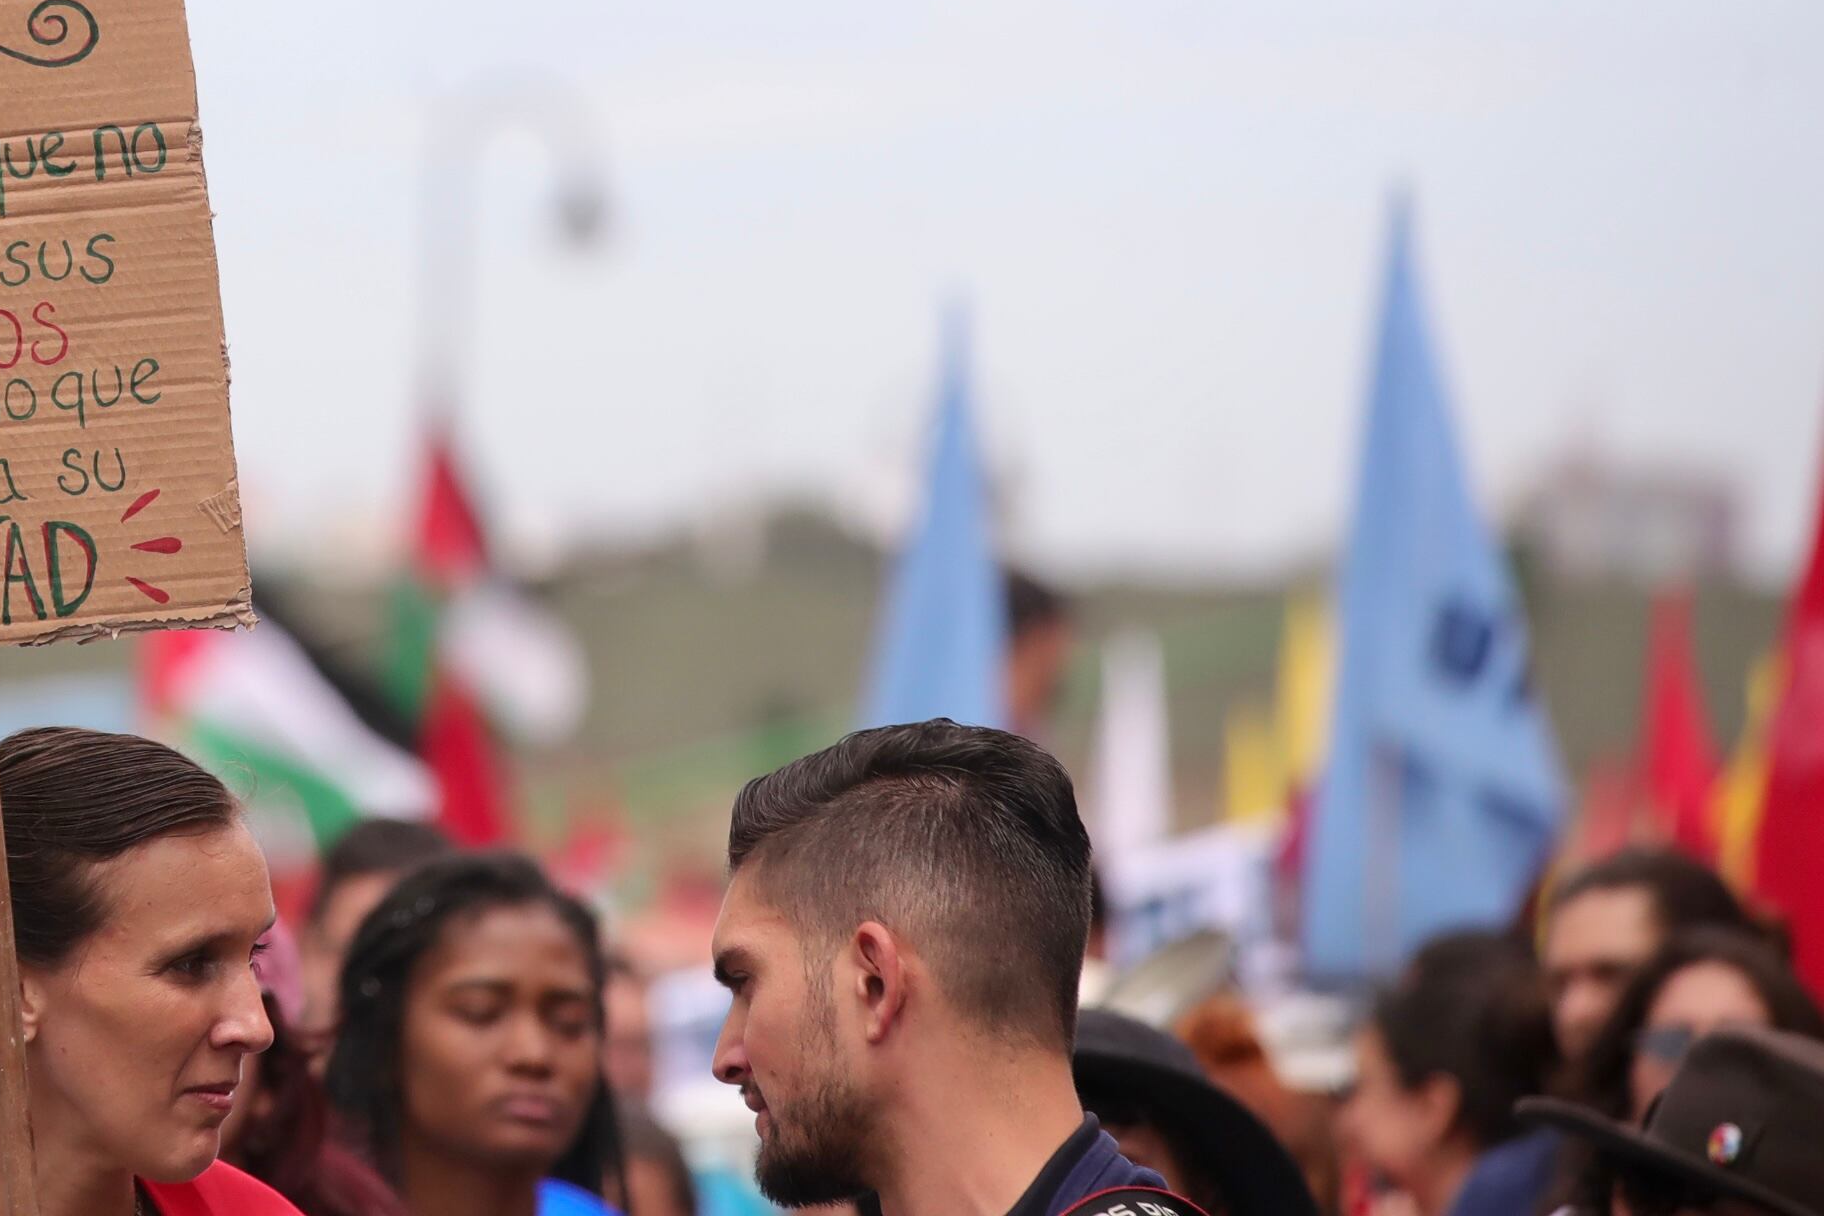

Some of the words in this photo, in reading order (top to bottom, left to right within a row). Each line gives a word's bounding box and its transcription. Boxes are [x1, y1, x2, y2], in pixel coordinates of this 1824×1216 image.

[92, 121, 167, 180] no
[50, 357, 162, 430] que
[58, 446, 126, 495] su
